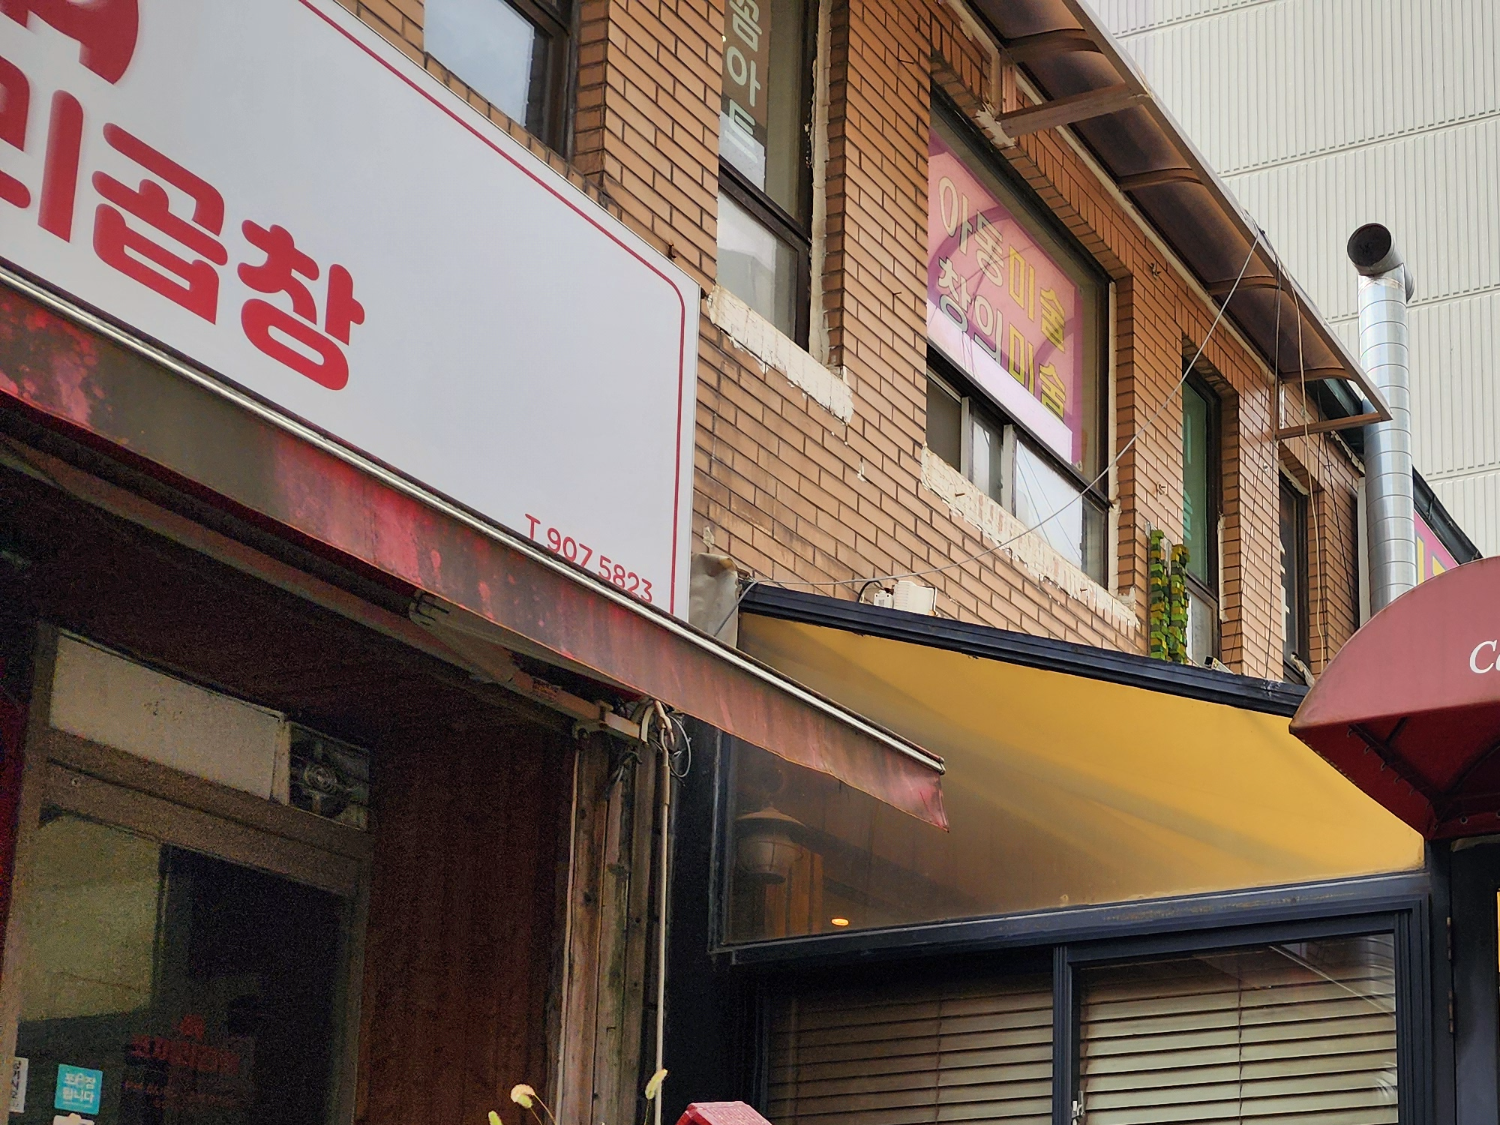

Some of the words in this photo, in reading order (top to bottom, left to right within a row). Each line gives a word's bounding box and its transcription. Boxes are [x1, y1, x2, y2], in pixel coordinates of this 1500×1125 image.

[938, 176, 1066, 353] 아동미술
[938, 256, 1067, 423] 창의미술
[547, 527, 593, 568] 907
[598, 555, 653, 603] 5823
